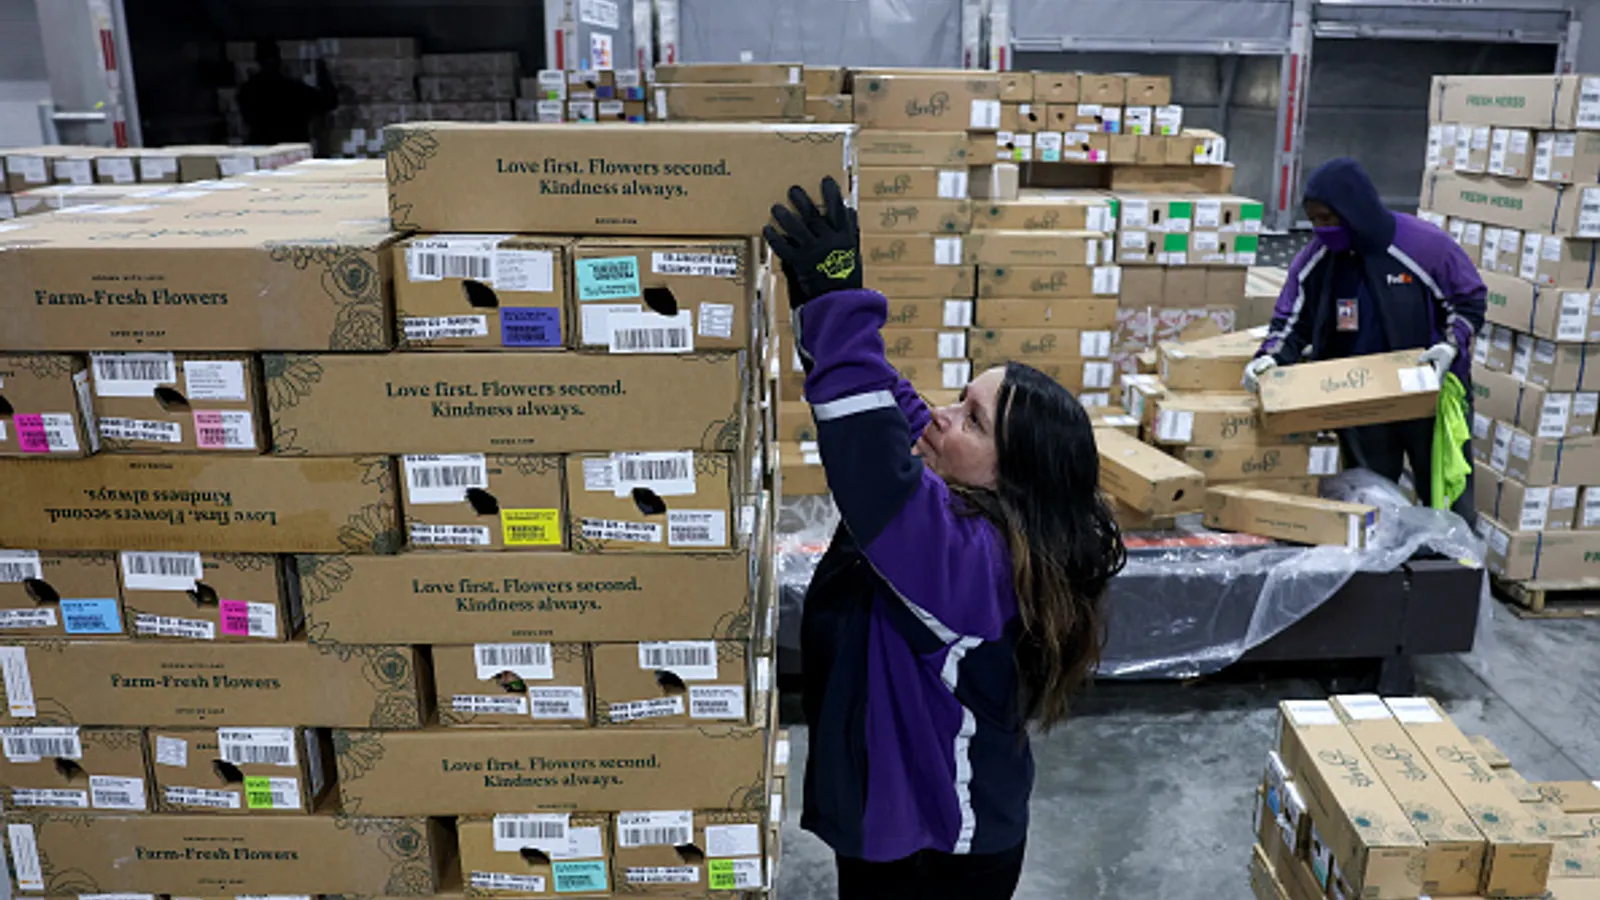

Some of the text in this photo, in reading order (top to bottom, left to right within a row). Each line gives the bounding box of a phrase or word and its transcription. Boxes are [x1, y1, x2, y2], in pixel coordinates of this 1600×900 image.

[497, 158, 731, 175] Love first. Flowers second.
[539, 178, 688, 199] Kindness always.
[35, 288, 228, 306] Farm-Fresh Flowers
[386, 379, 627, 397] Love first. Flowers second.
[431, 401, 585, 421] Kindness always.
[83, 486, 232, 507] Kindness always.
[43, 507, 278, 526] Love first. Flowers second.
[412, 576, 643, 594] Love first. Flowers second.
[455, 597, 602, 614] Kindness always.
[111, 673, 281, 690] Farm-Fresh Flowers
[441, 754, 661, 772] Love first. Flowers second.
[483, 772, 624, 788] Kindness always.
[135, 846, 299, 861] Farm-Fresh Flowers
